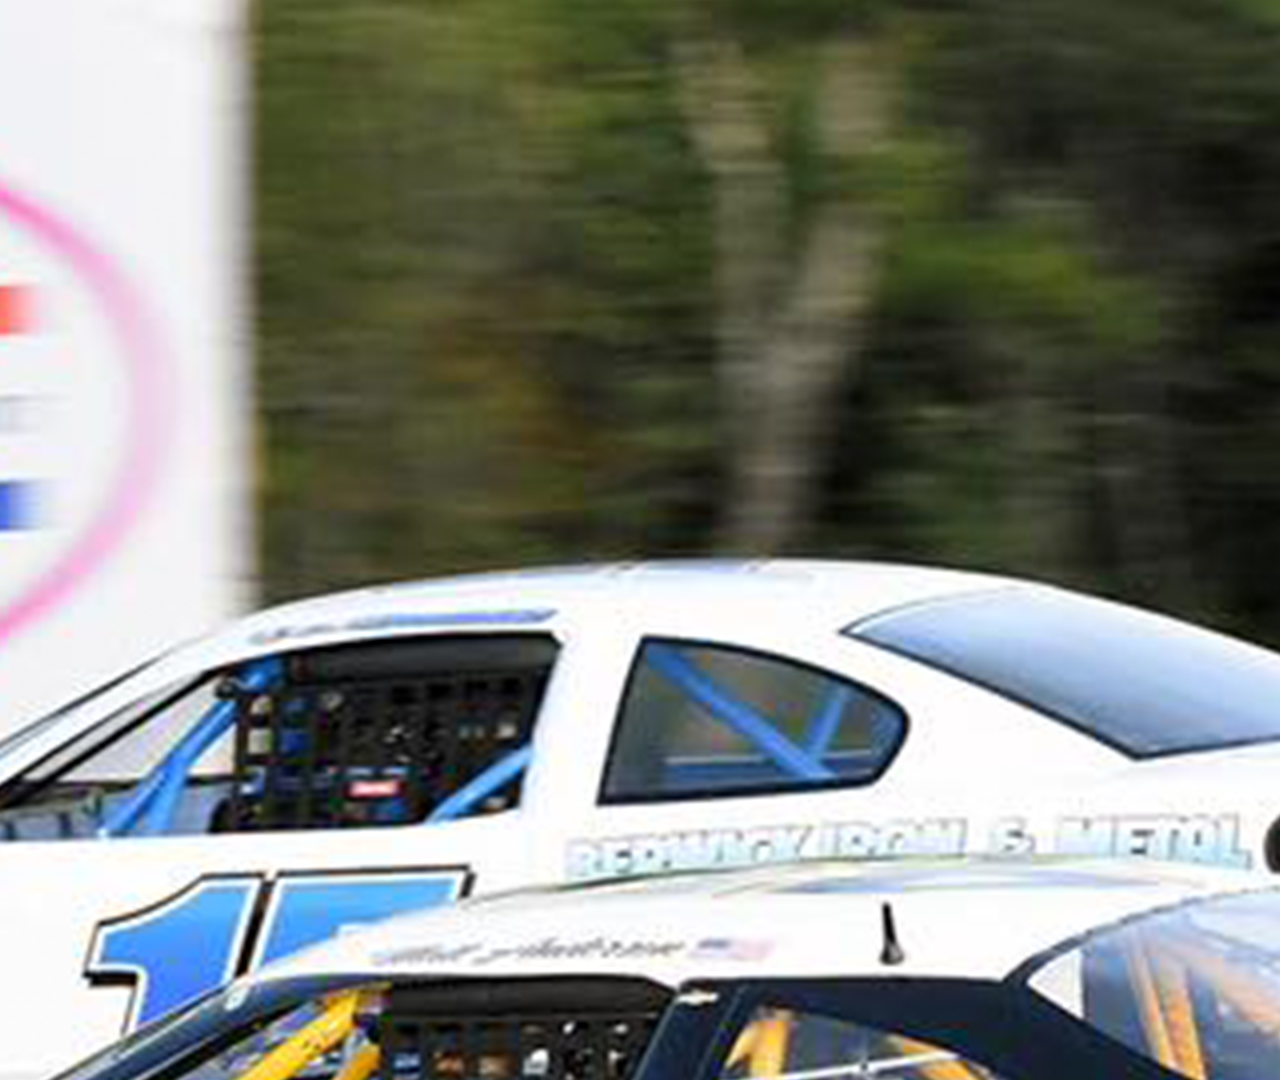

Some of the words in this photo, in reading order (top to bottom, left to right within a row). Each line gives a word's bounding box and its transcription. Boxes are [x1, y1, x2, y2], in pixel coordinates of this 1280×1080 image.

[821, 818, 969, 861] IRON
[988, 817, 1035, 855] &
[1055, 813, 1252, 871] METAL
